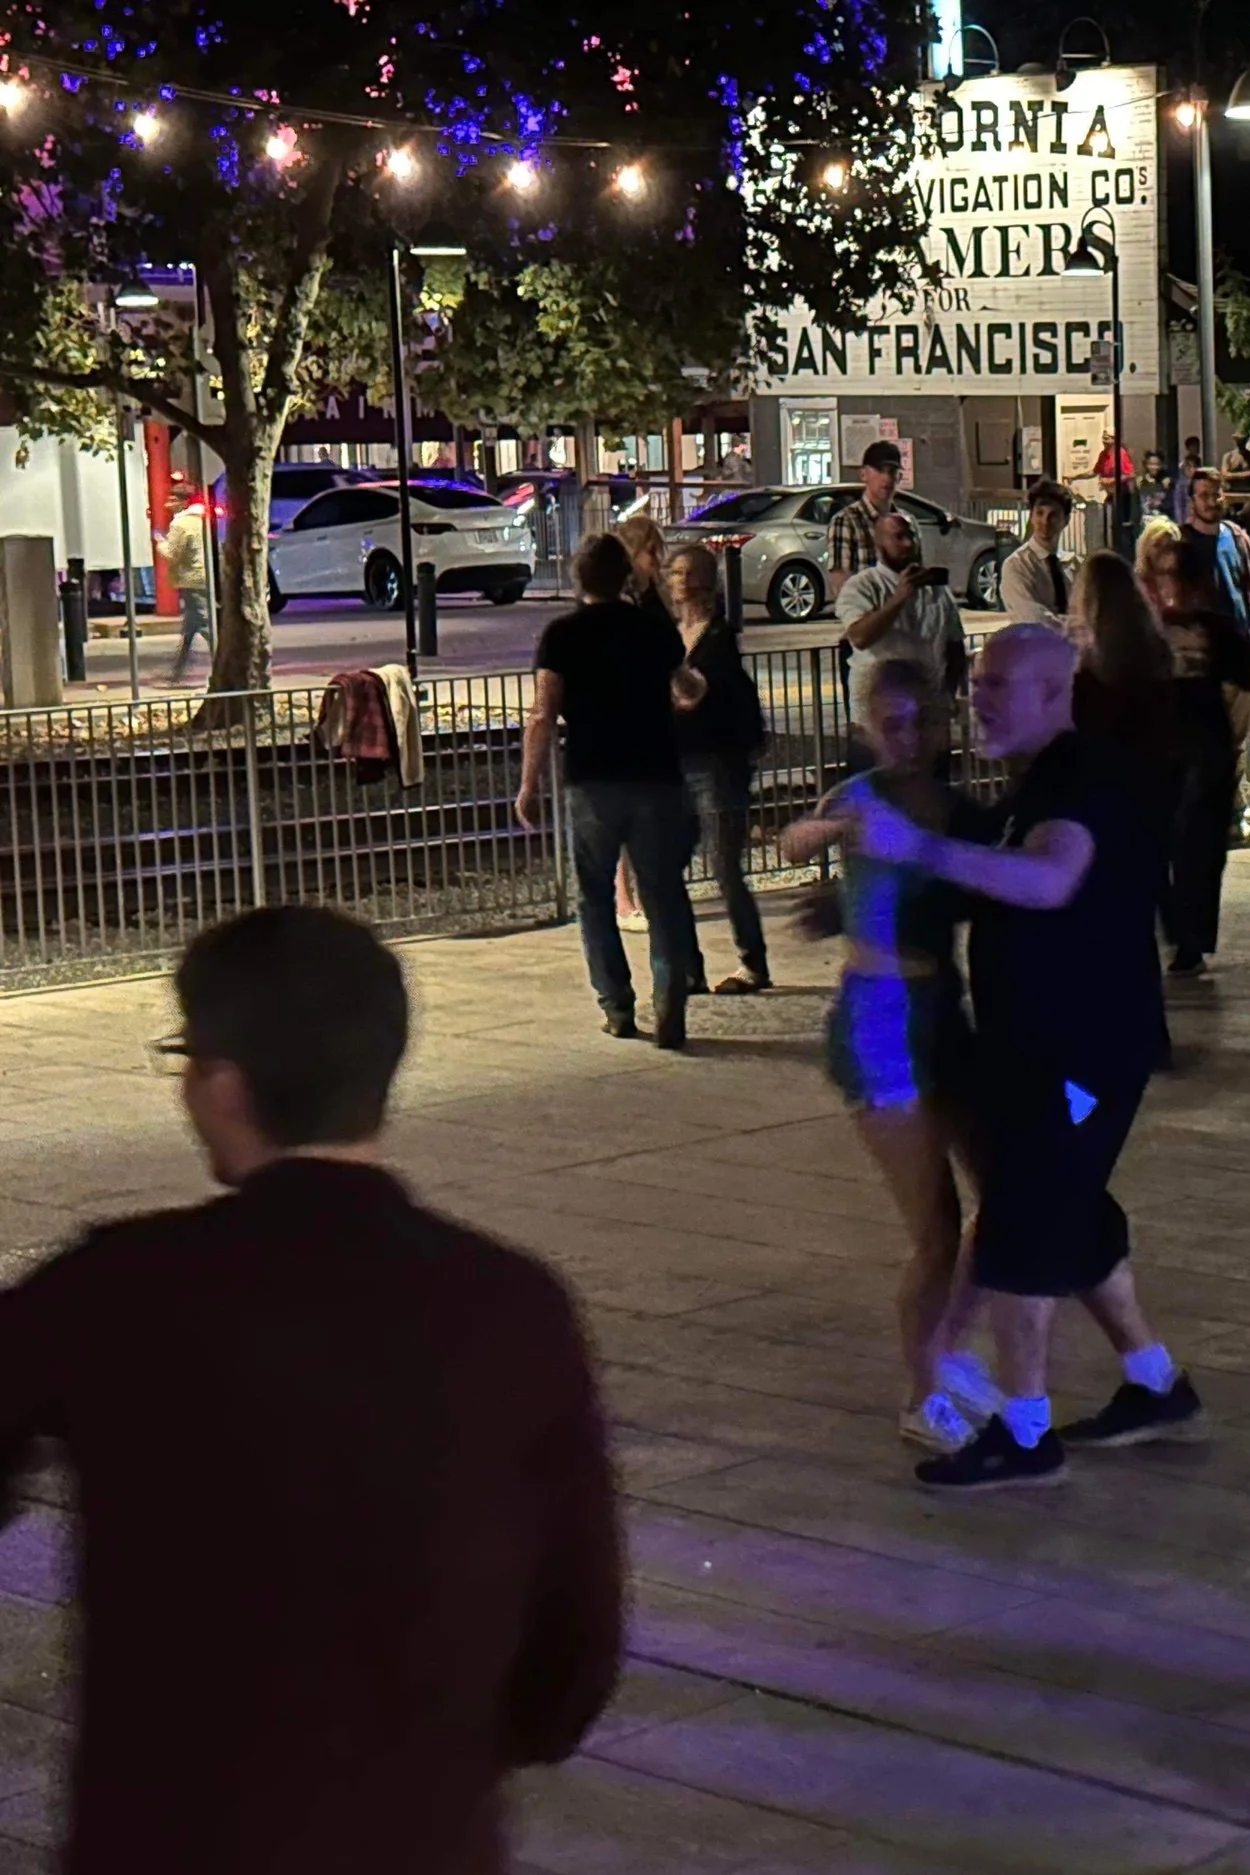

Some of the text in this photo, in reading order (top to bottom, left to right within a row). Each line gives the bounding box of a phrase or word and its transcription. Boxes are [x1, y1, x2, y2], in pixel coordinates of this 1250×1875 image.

[936, 99, 1116, 160] ORNIA
[913, 171, 1069, 217] VIGATION
[922, 287, 972, 312] FOR
[768, 324, 848, 376] SAN
